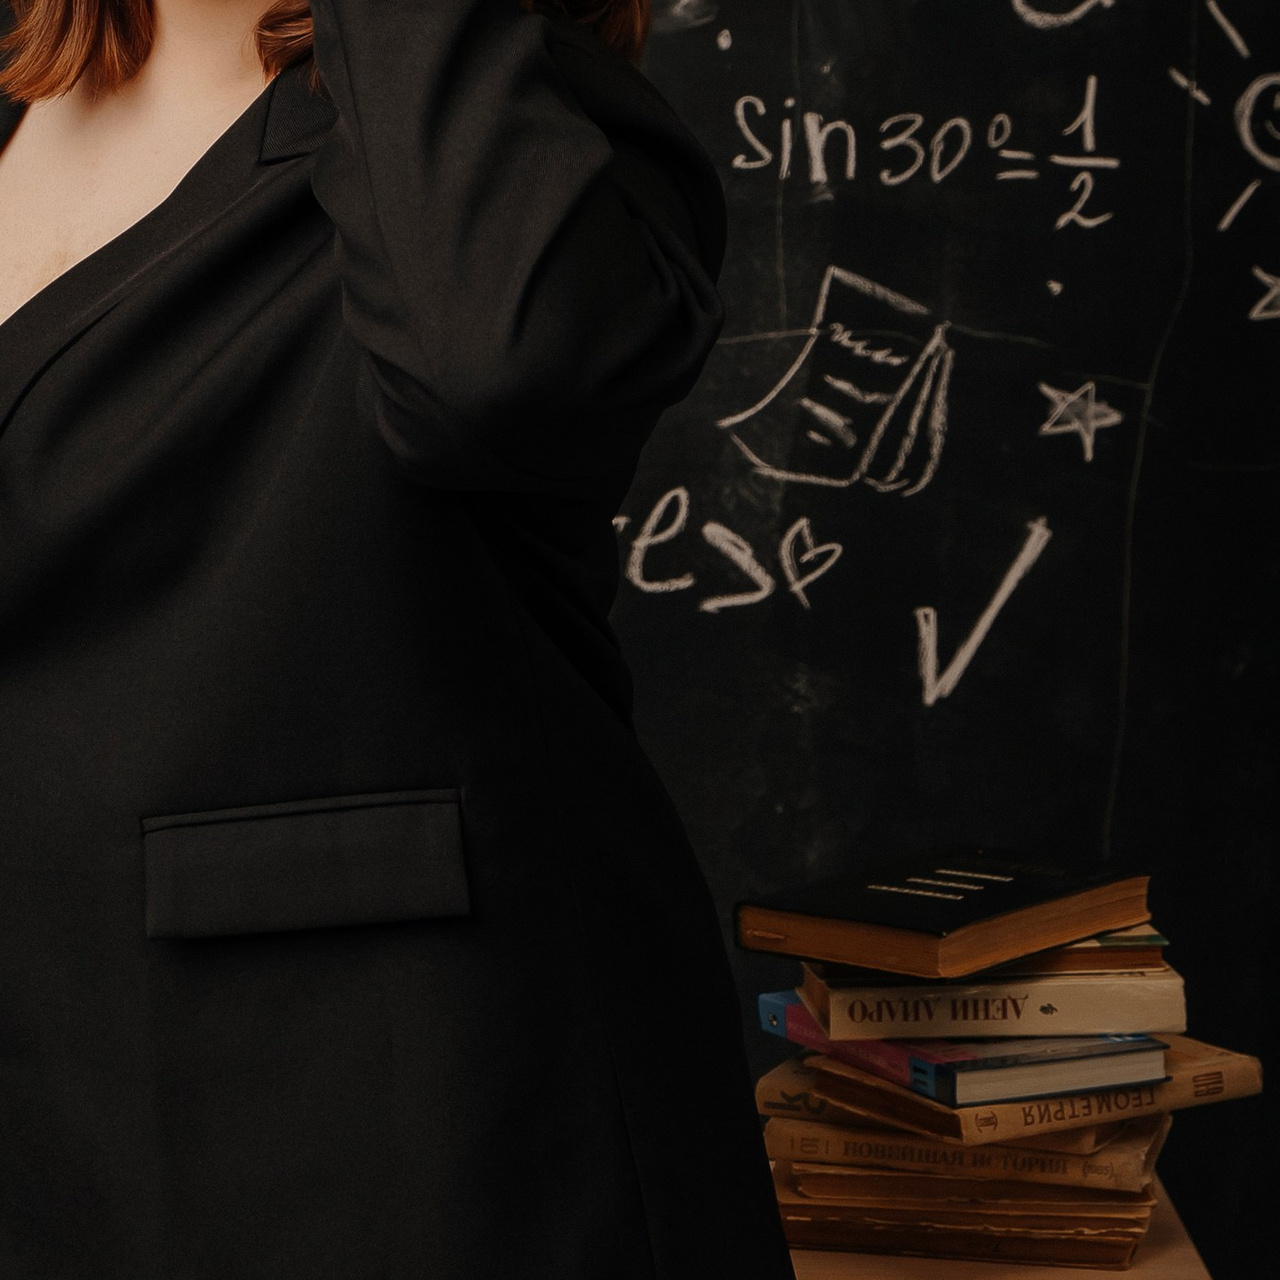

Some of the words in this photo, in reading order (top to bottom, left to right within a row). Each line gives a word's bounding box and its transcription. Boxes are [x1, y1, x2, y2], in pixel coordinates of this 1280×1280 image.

[950, 993, 1029, 1023] ДЕНИ
[1021, 1088, 1156, 1128] ГЕОМЕТРИЯ
[842, 1139, 966, 1169] НОВЕЙШАЯ
[970, 1145, 1069, 1176] ИСТОРИЯ
